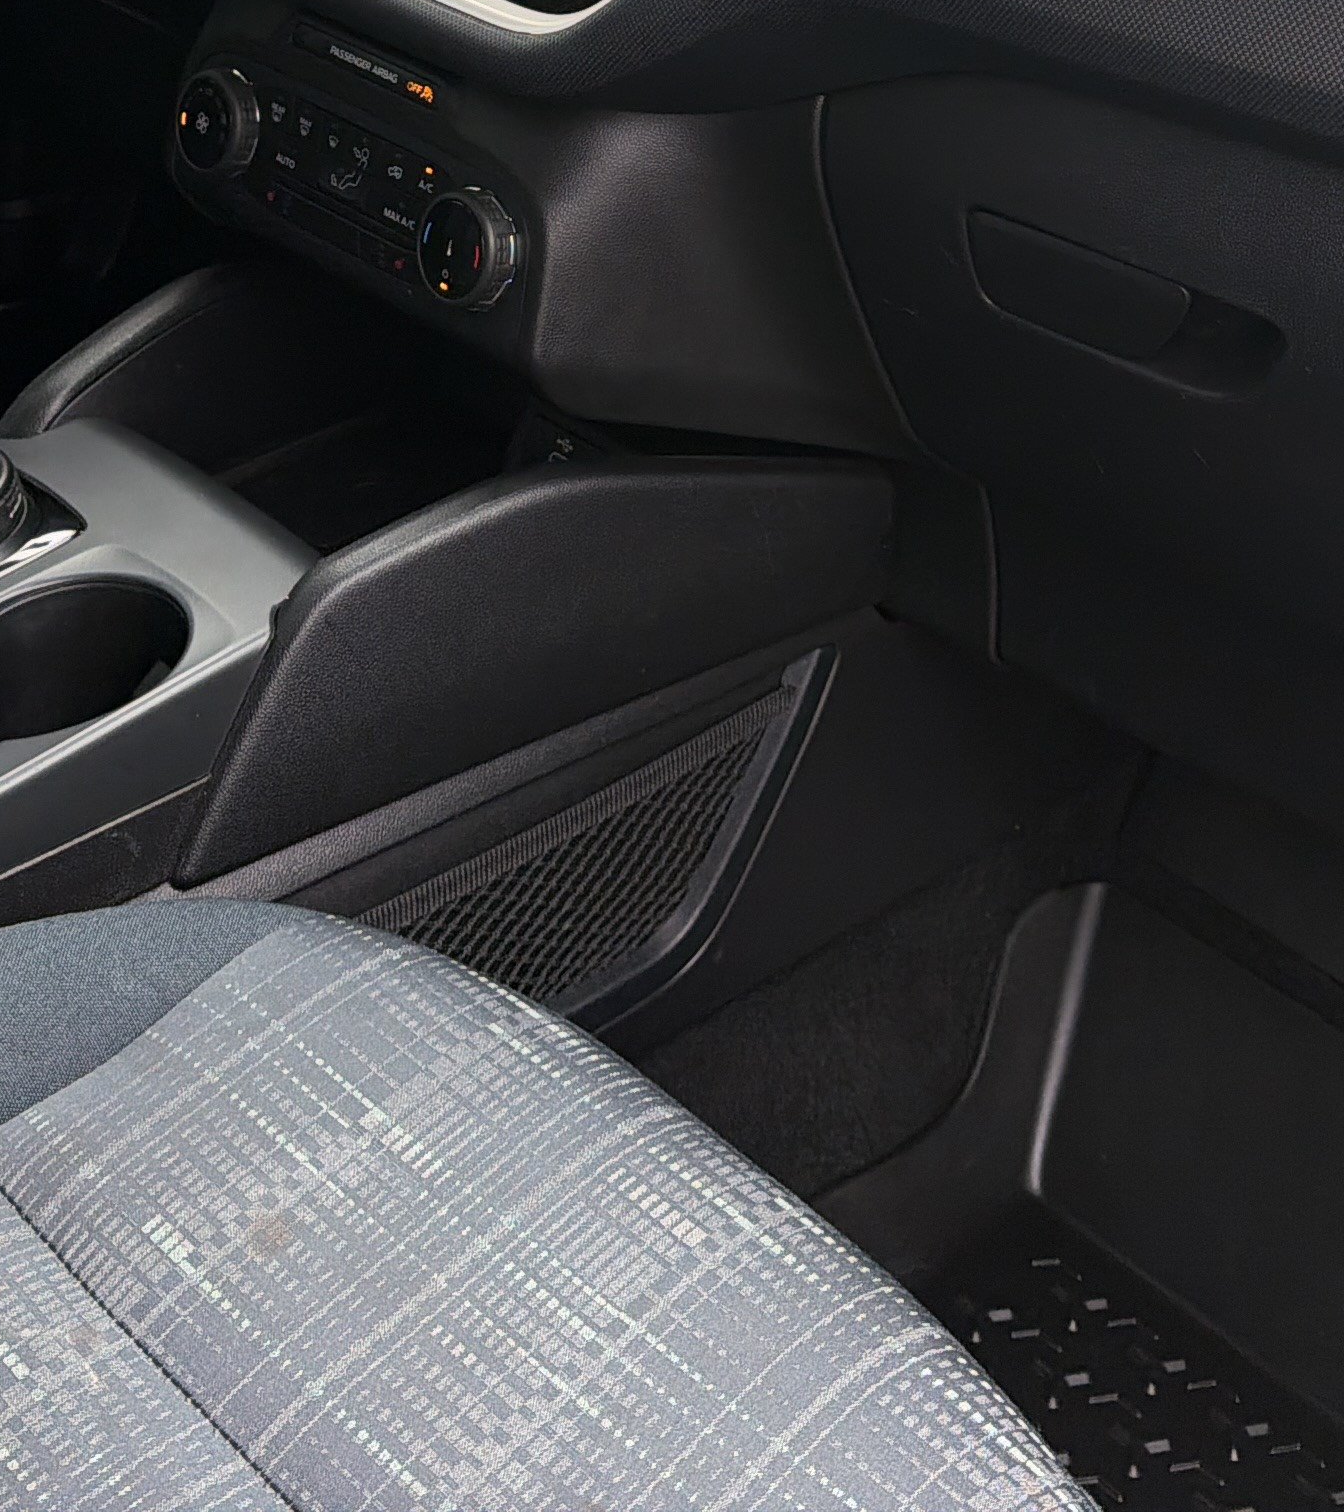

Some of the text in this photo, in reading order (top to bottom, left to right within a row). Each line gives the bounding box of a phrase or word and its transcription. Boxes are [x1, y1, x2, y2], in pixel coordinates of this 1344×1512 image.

[329, 45, 423, 94] PASSENGER AIRBAG OFF
[275, 152, 296, 169] AUTO
[418, 179, 434, 194] A/C
[383, 207, 416, 230] MAX A/C
